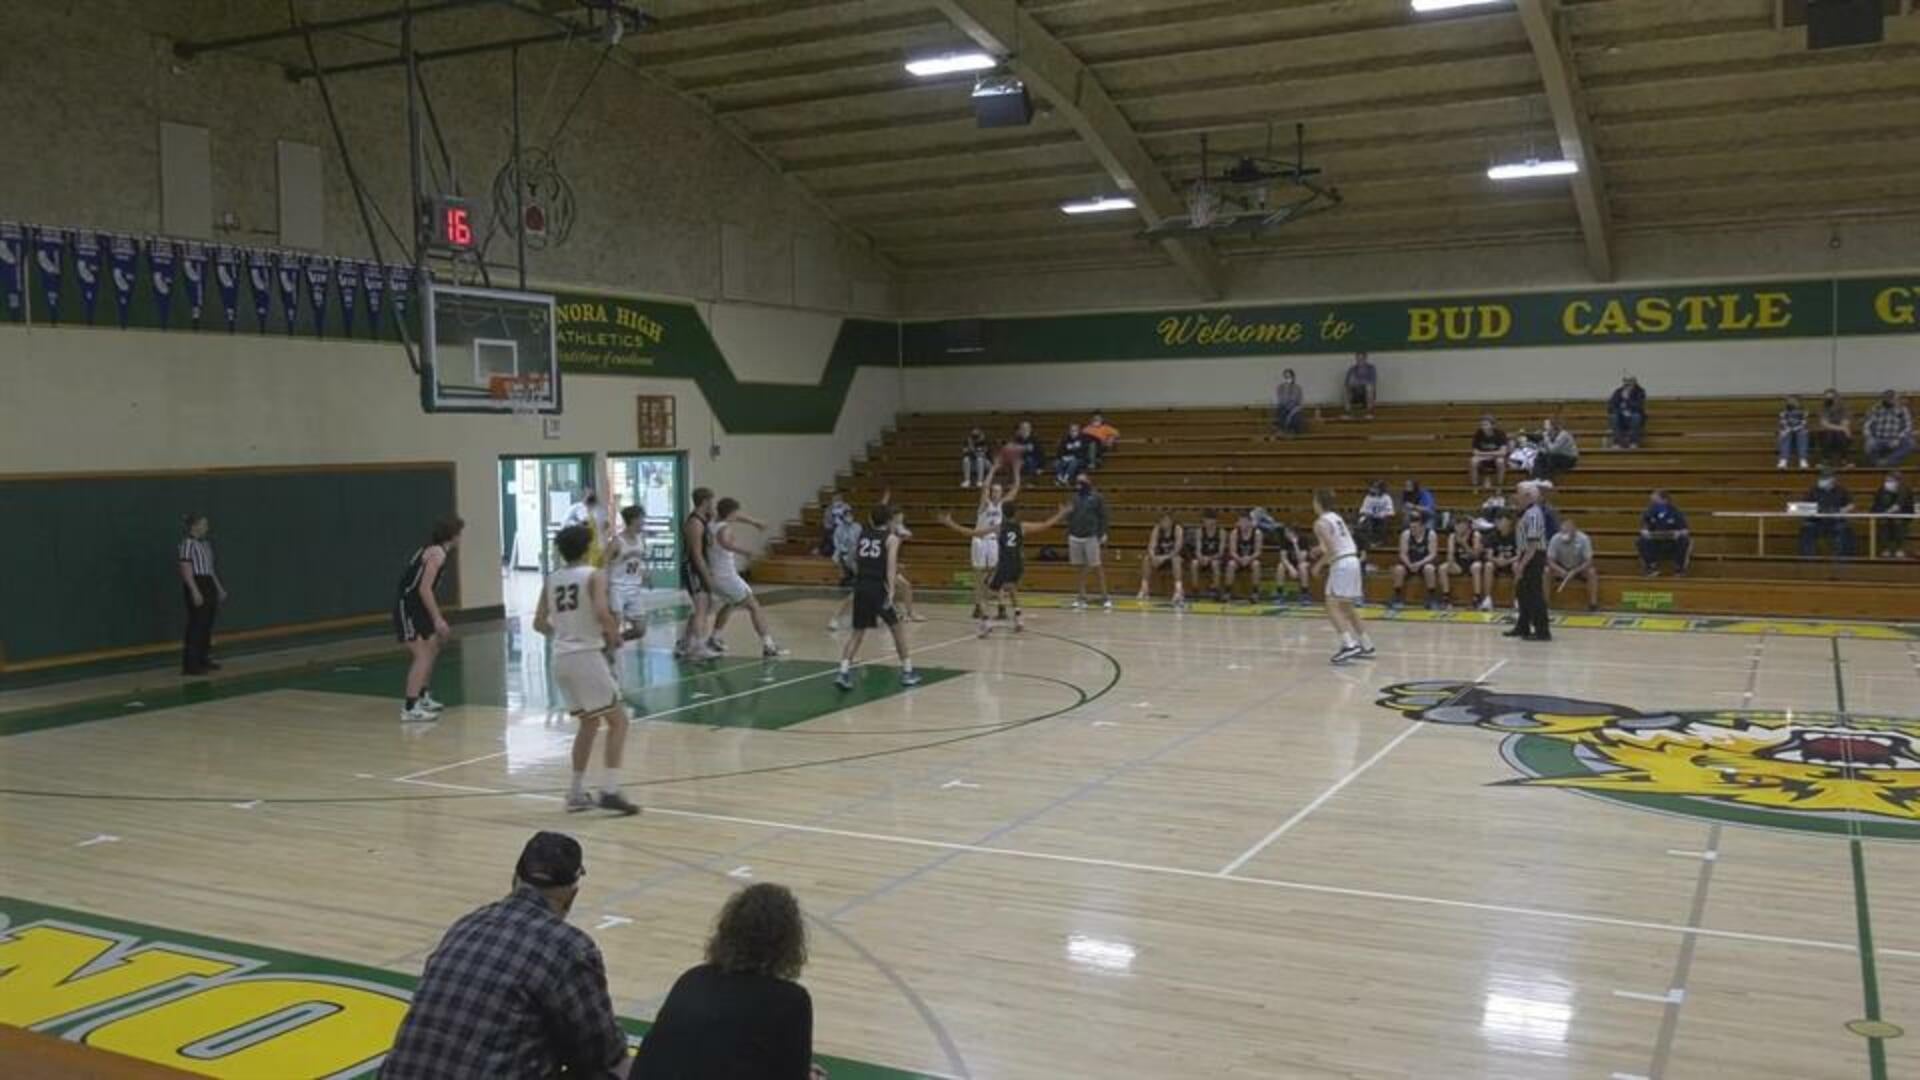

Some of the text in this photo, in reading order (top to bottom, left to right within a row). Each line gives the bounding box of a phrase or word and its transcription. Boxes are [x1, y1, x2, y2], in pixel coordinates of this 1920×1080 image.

[448, 208, 471, 244] 16
[616, 307, 663, 343] HIGH
[1156, 286, 1920, 345] Welcome to BUD CASTLE G
[557, 329, 643, 347] ATHLETICS
[859, 538, 881, 557] 25
[1007, 531, 1017, 547] 2
[556, 583, 579, 612] 23
